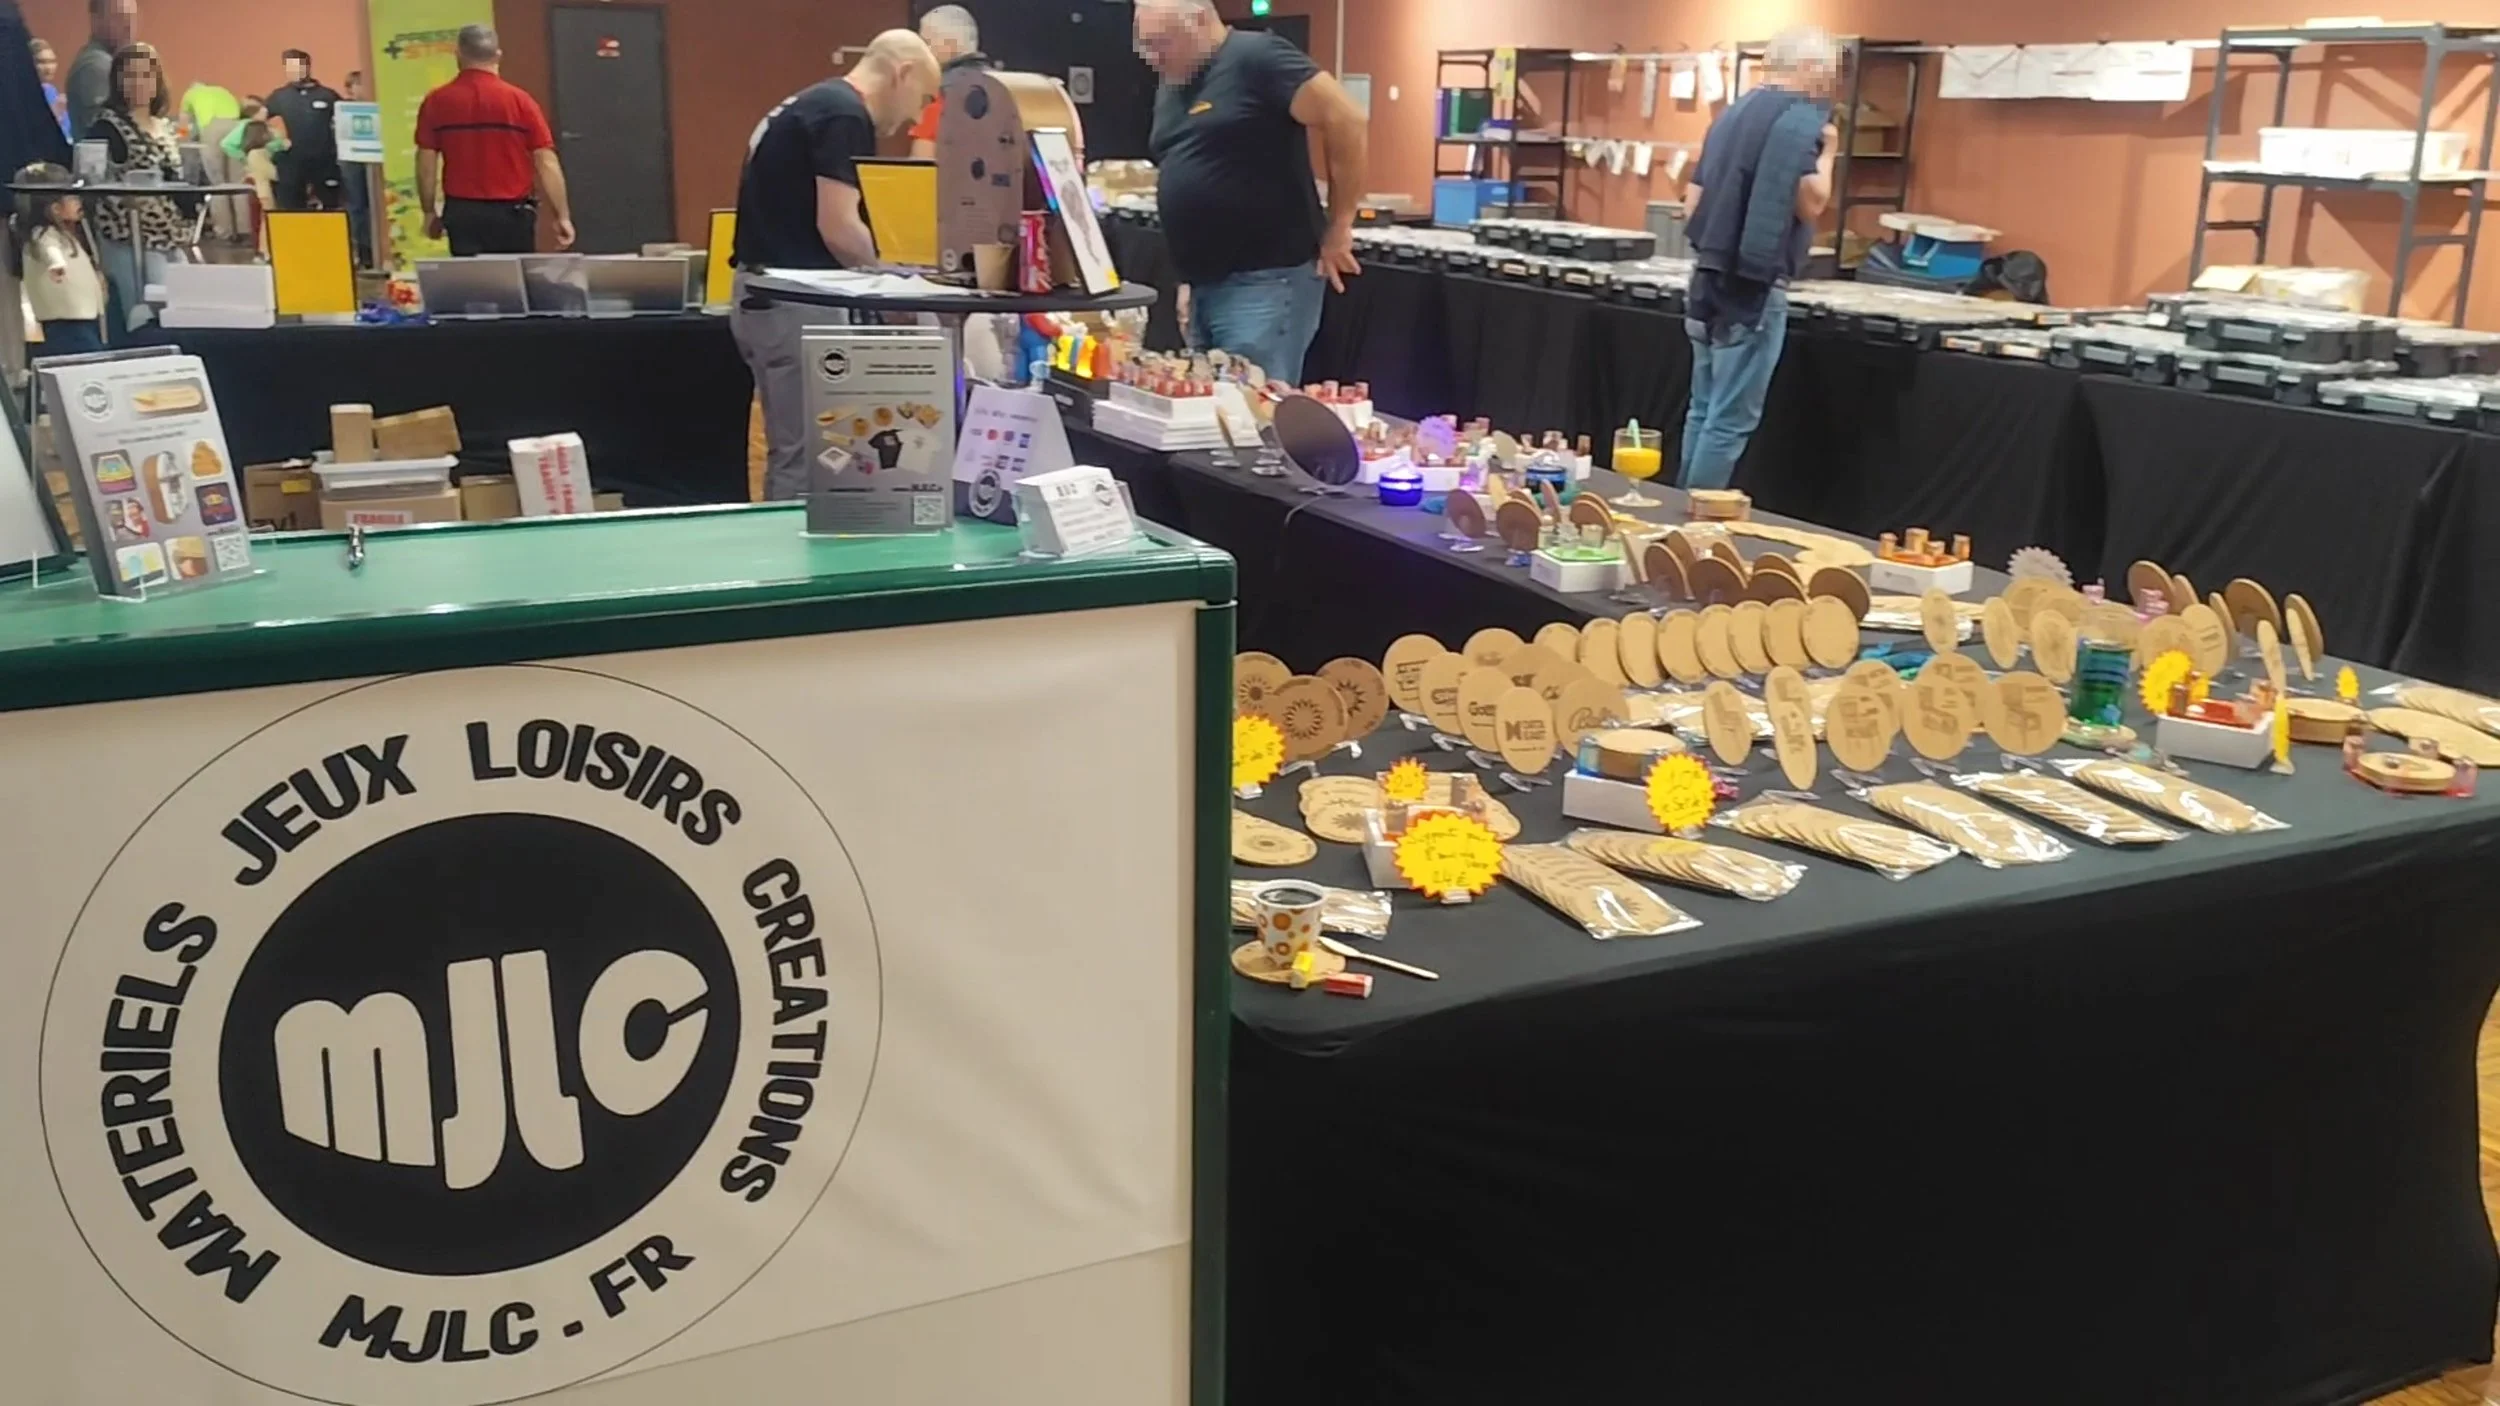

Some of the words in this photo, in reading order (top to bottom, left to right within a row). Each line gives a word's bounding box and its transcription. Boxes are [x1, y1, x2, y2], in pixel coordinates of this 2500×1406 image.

[100, 901, 281, 1305] MATERIELS
[220, 734, 418, 886] JEUX
[465, 719, 742, 846] LOISIRS
[720, 858, 829, 1203] CREATIONS
